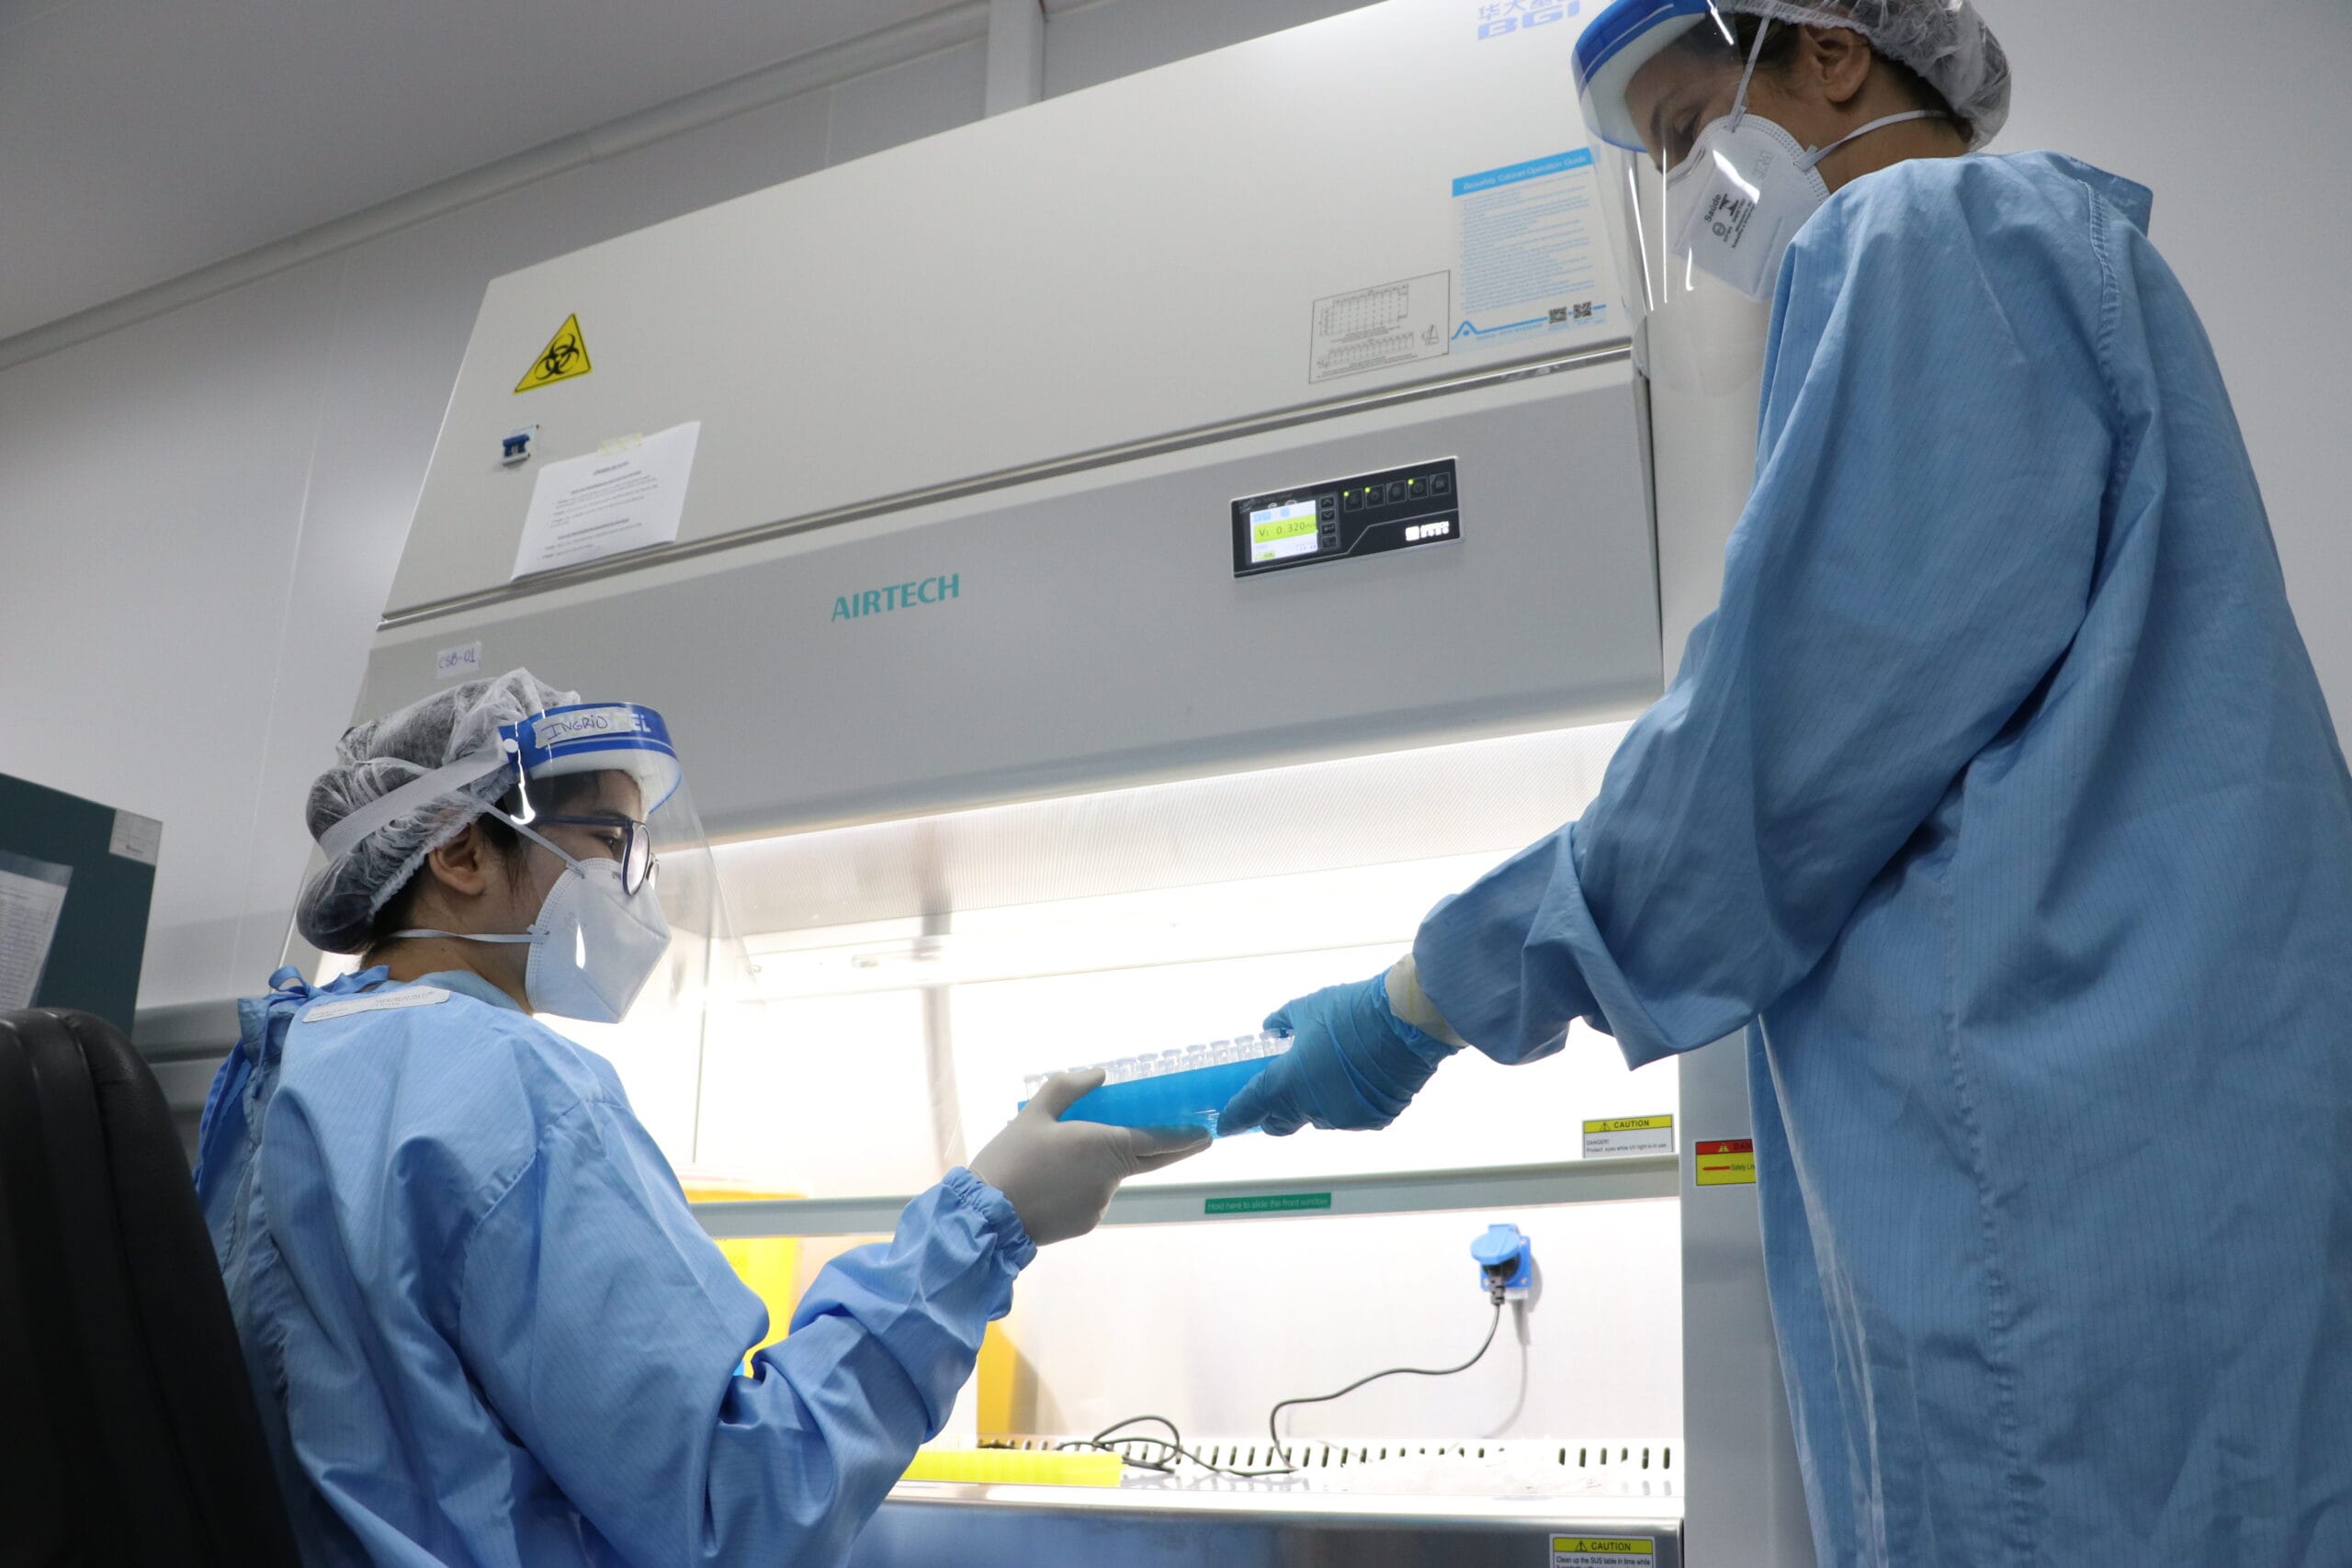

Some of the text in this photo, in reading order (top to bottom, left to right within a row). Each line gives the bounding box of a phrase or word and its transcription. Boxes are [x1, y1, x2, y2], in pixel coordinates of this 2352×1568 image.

[1478, 0, 1566, 21] 华大
[1477, 0, 1580, 40] BGI
[831, 572, 959, 623] AIRTECH
[1613, 1119, 1650, 1130] CAUTION
[1734, 1142, 1753, 1150] DAN
[1270, 1200, 1282, 1208] the
[1283, 1199, 1299, 1207] front
[1590, 1541, 1631, 1551] CAUTION
[1636, 1558, 1650, 1566] while
